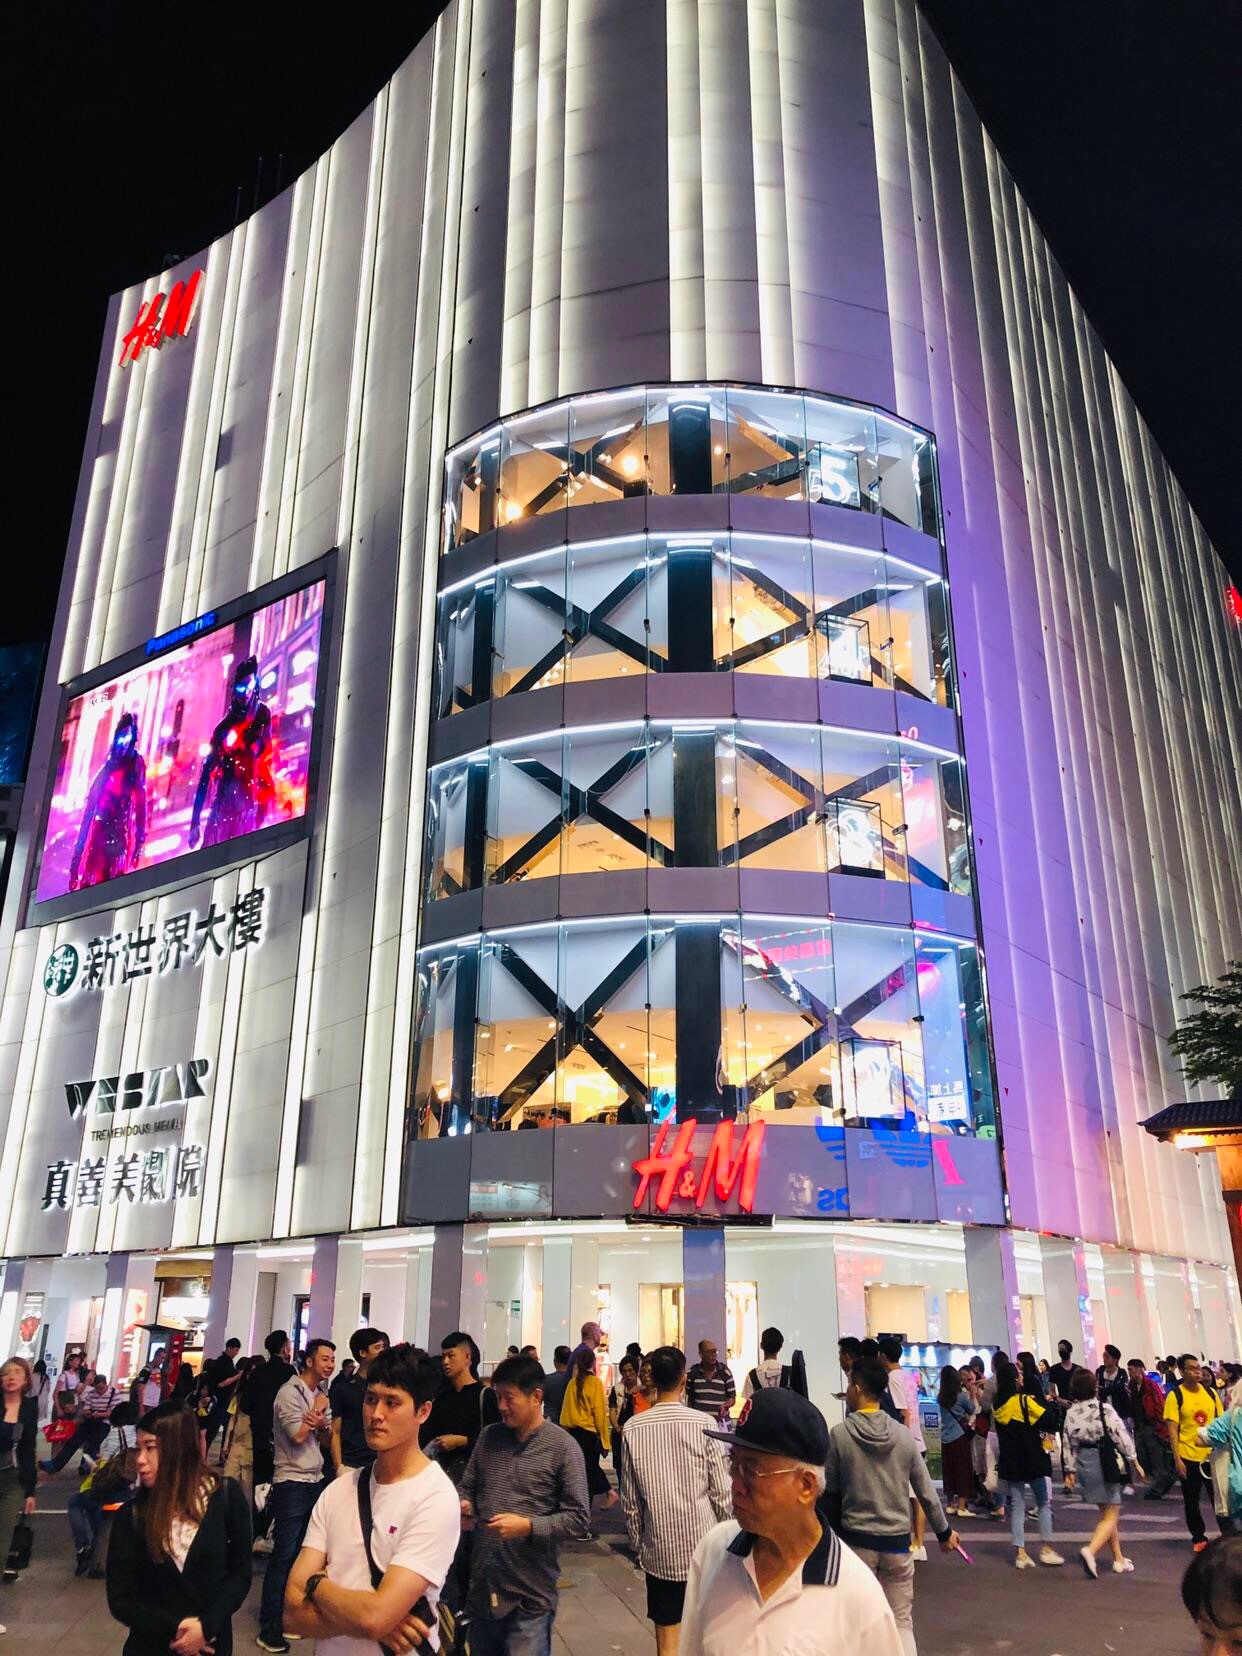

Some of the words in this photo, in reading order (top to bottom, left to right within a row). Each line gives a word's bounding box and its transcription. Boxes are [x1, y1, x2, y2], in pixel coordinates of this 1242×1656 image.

[119, 267, 203, 366] H&M
[820, 454, 849, 502] 5
[81, 886, 265, 992] 新世界大樓
[91, 1121, 150, 1141] TREMENDOUS
[632, 1115, 765, 1213] H&M
[42, 1145, 203, 1212] 真善美劇院
